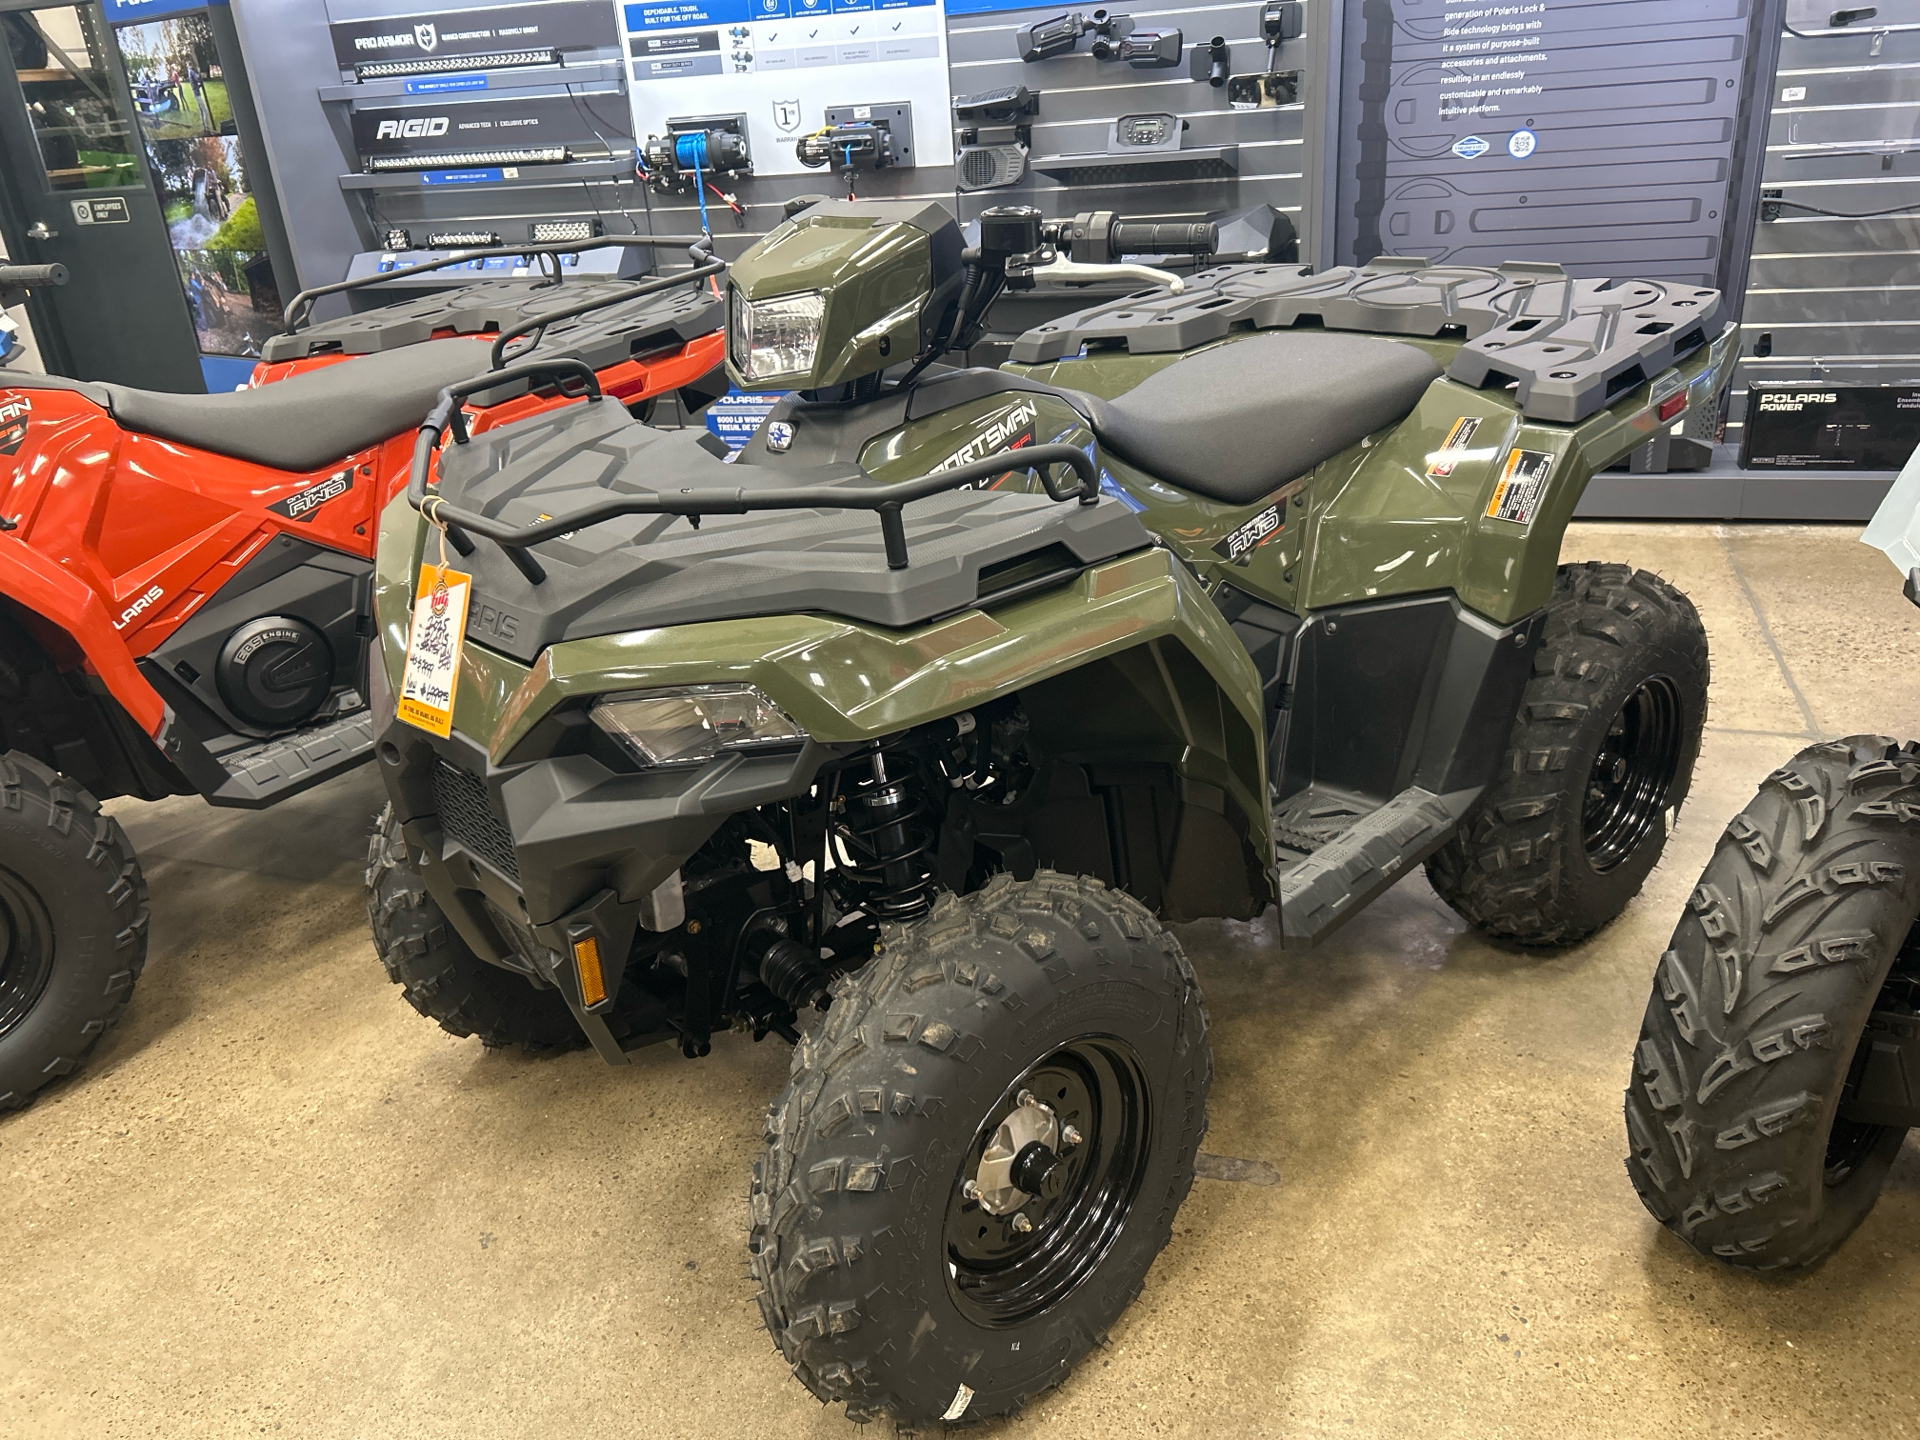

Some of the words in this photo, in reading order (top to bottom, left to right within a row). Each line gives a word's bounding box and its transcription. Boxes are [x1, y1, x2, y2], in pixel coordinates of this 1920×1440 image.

[643, 7, 679, 16] DEPENDABLE.
[1444, 9, 1483, 22] generation
[1484, 8, 1492, 16] of
[1493, 6, 1518, 16] Polaris
[1520, 4, 1538, 14] Lock
[1539, 3, 1546, 12] &
[645, 16, 660, 24] BUILT
[458, 30, 490, 39] CONSTRUCTION
[1444, 28, 1460, 36] Ride
[1460, 24, 1500, 35] technology
[1501, 22, 1524, 31] brings
[1526, 20, 1542, 29] with
[1442, 44, 1448, 52] it
[1455, 42, 1480, 52] system
[1482, 40, 1489, 49] of
[1490, 37, 1540, 50] purpose-built
[1442, 58, 1484, 68] accessories
[1485, 56, 1498, 65] and
[1500, 53, 1548, 64] attachments,
[1440, 74, 1472, 84] resulting
[1472, 73, 1480, 81] in
[1491, 70, 1525, 80] endlessly
[1440, 89, 1486, 100] customizable
[1487, 88, 1501, 96] and
[1502, 85, 1543, 95] remarkably
[780, 108, 791, 125] 1
[1438, 106, 1467, 115] intuitive
[1468, 104, 1500, 114] platform.
[376, 116, 450, 140] RIGID
[500, 119, 522, 127] EXCLUSIVE
[1760, 393, 1837, 403] POLARIS
[287, 495, 300, 504] ON
[289, 480, 346, 516] AWD
[1227, 531, 1238, 543] ON
[1241, 506, 1277, 533] DEMAND
[1230, 512, 1279, 558] AWD
[237, 636, 261, 661] EBS
[262, 631, 298, 640] ENGINE
